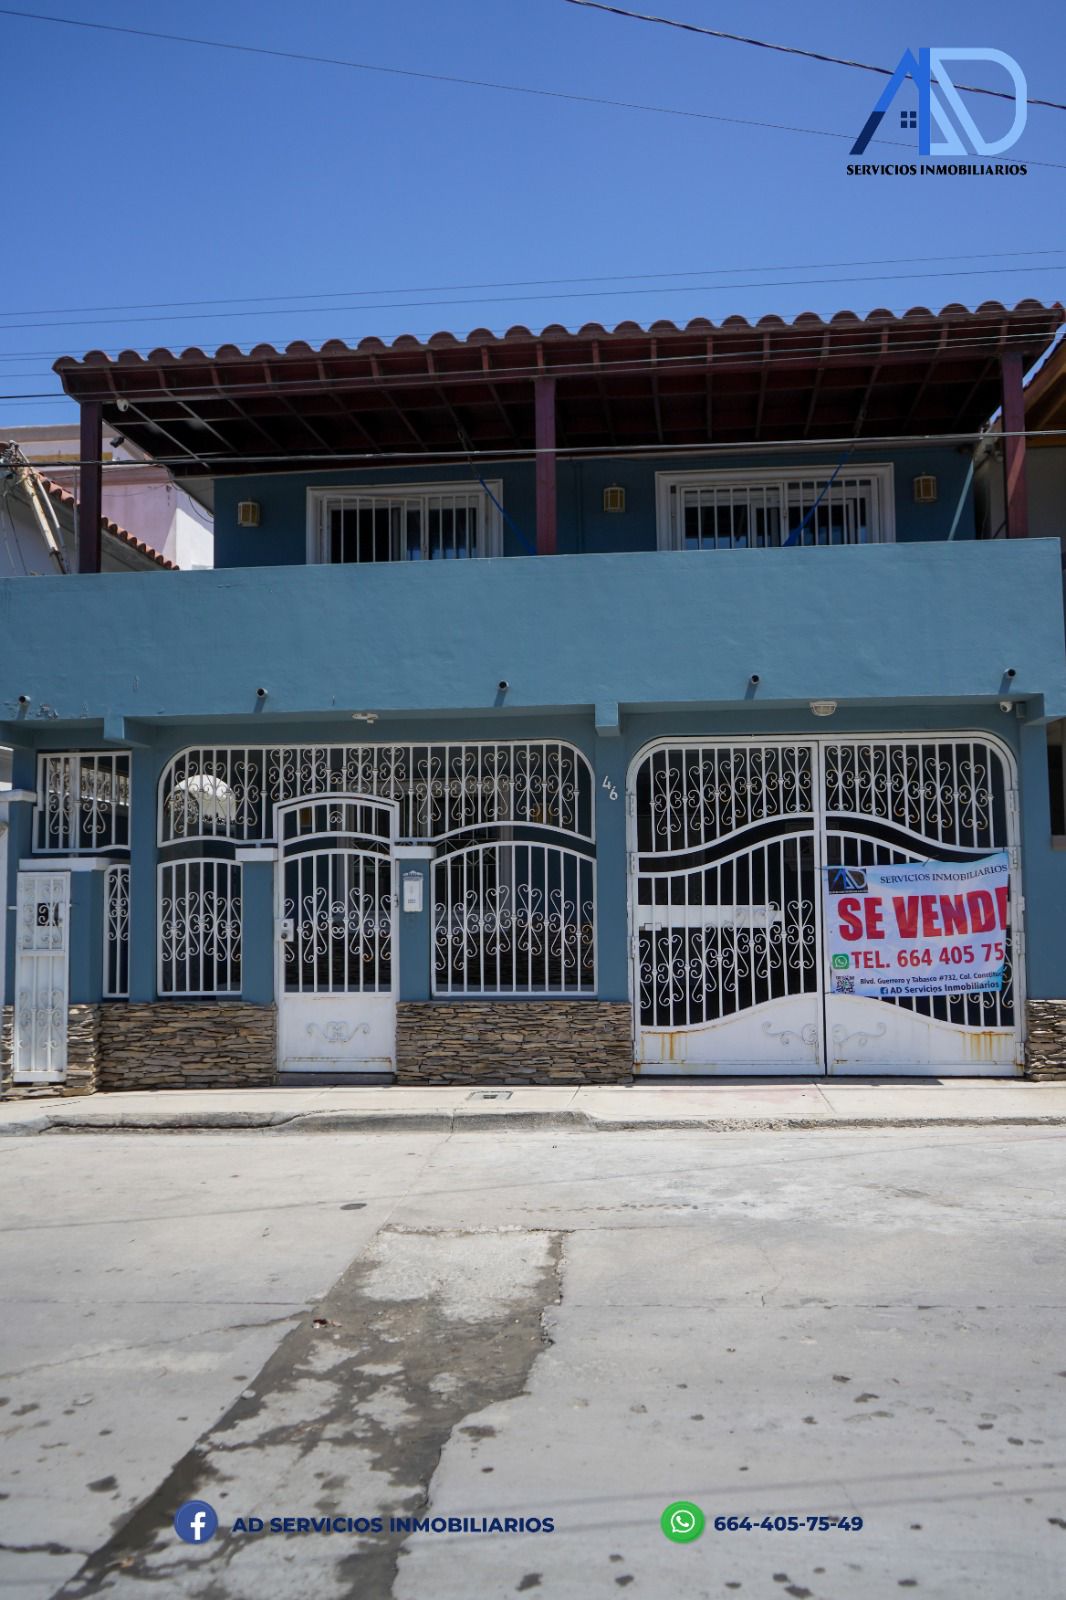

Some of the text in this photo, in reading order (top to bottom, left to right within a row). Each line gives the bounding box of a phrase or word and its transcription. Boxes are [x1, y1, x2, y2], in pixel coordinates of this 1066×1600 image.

[602, 775, 618, 801] 46
[880, 864, 1008, 884] SERVICIOS INMOBILIARIOS
[837, 896, 885, 942] SE
[851, 942, 1004, 969] TEL. 664 405 75
[878, 977, 905, 985] Guerrero
[912, 975, 937, 983] Tabasco
[959, 972, 972, 980] Col.
[905, 985, 942, 994] Servicios
[945, 981, 1000, 992] Inmobiliarios
